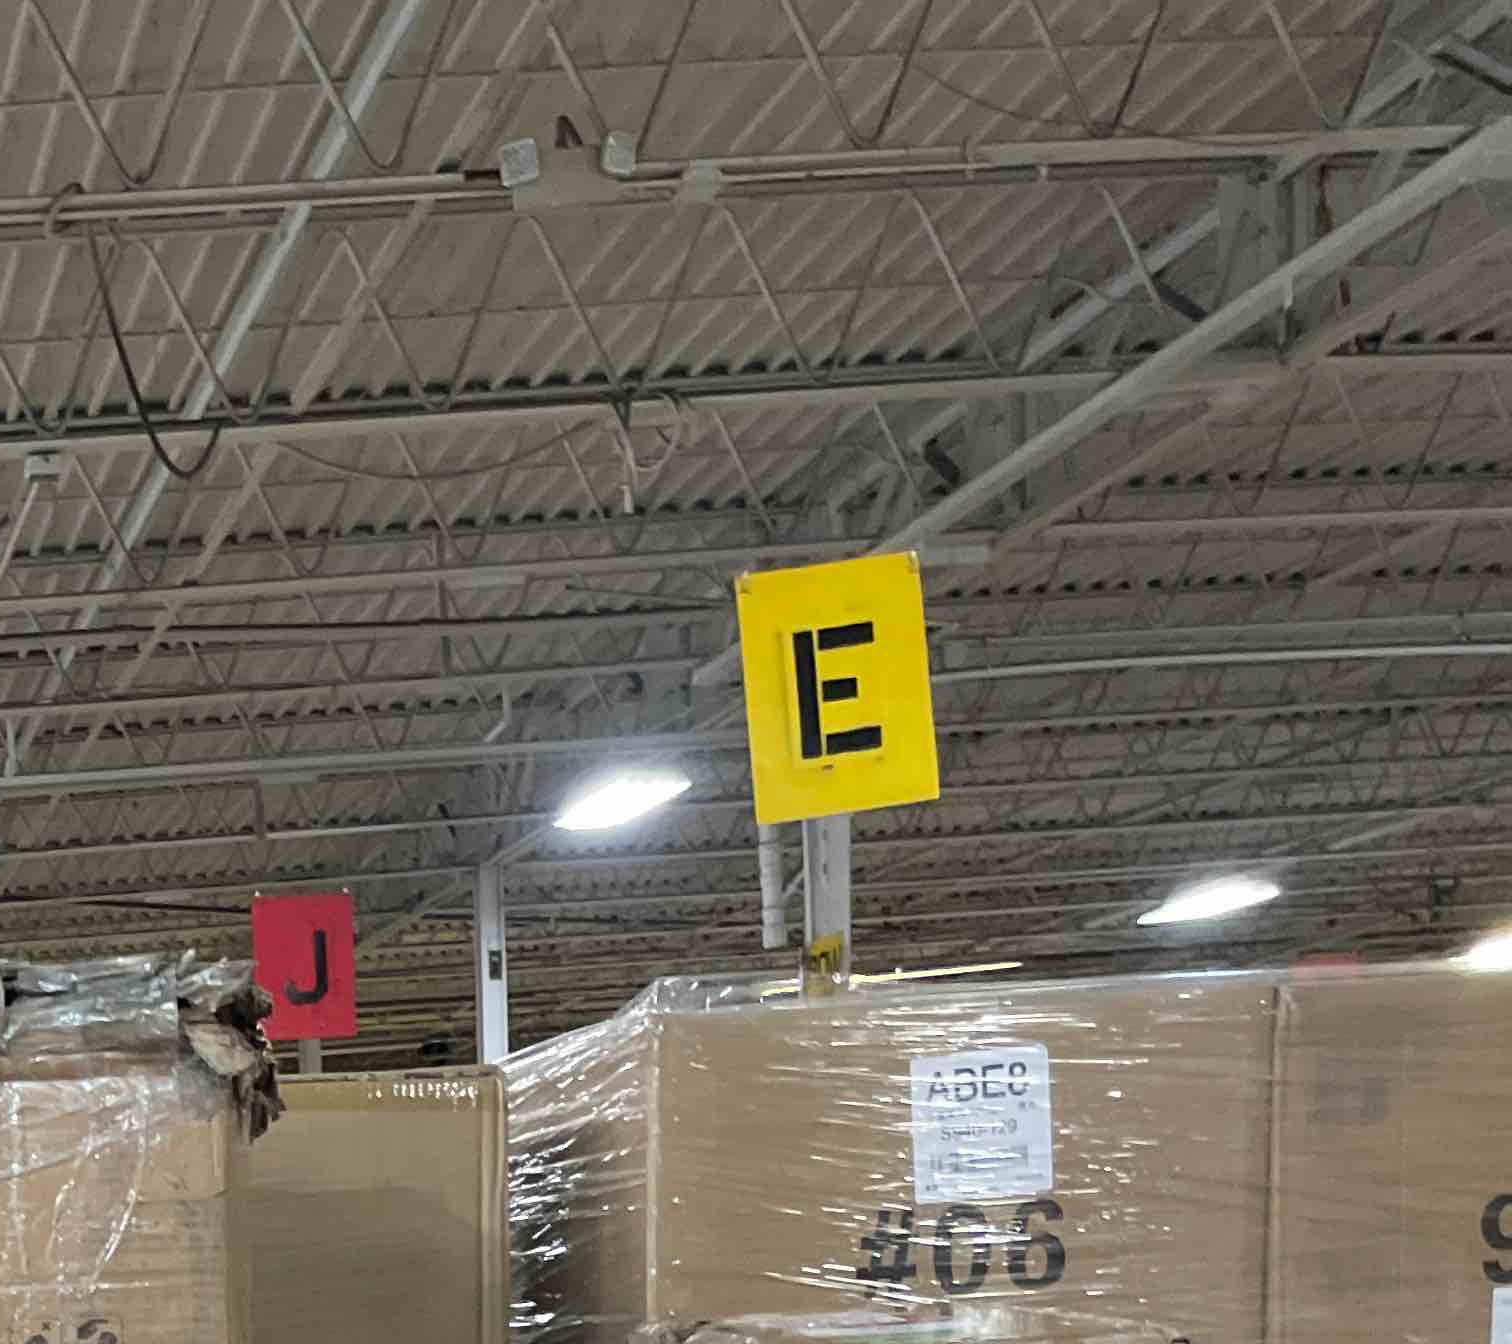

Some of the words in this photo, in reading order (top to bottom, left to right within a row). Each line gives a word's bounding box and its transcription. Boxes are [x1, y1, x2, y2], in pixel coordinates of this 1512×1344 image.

[792, 621, 882, 760] E
[282, 929, 329, 1004] J
[856, 1200, 1065, 1297] #06
